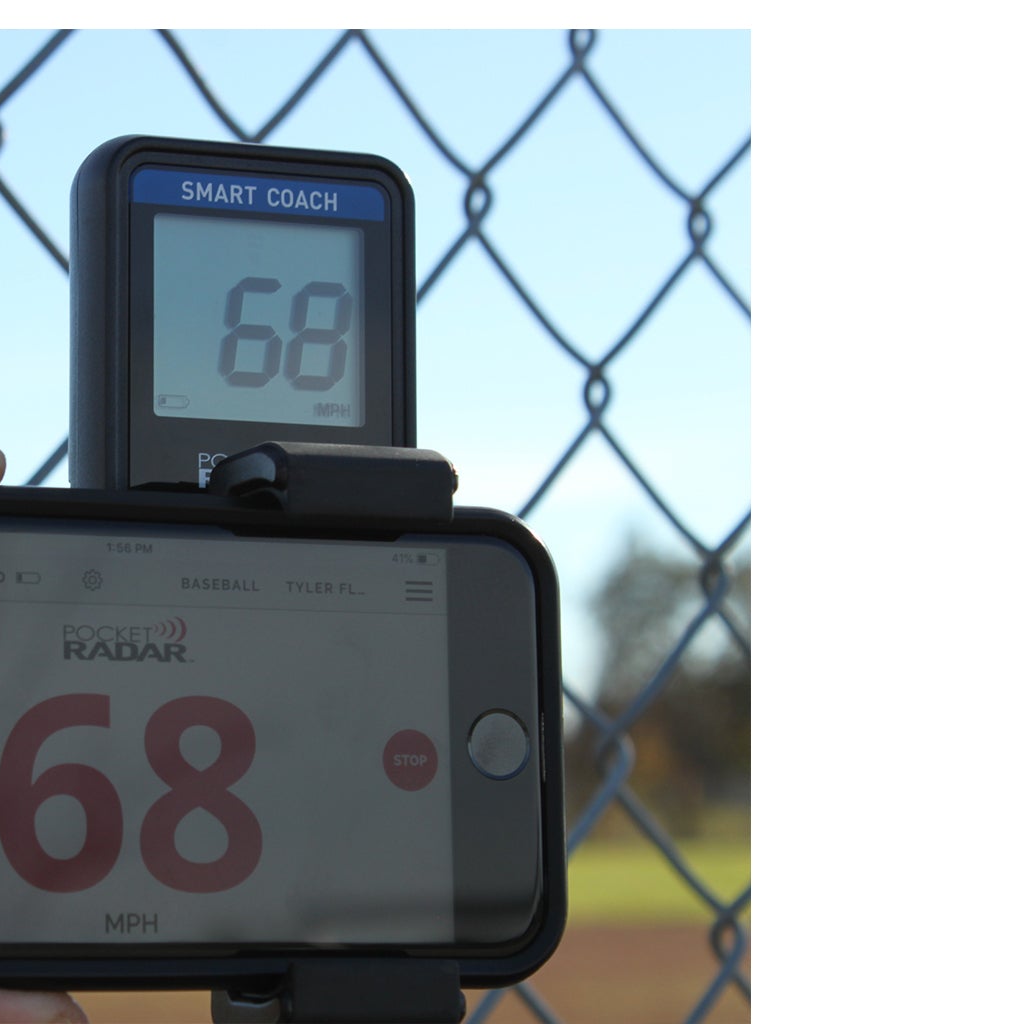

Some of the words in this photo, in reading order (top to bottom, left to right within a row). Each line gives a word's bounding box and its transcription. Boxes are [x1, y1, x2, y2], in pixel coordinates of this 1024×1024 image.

[181, 180, 257, 206] SMART
[267, 187, 338, 212] COACH
[217, 276, 353, 392] 68
[316, 402, 351, 419] MPH
[106, 542, 132, 554] 1:56
[135, 543, 153, 554] PM
[181, 577, 260, 592] BASEBALL
[286, 581, 333, 595] TYLER
[63, 624, 153, 643] POCKET
[63, 640, 187, 663] RADAR
[392, 752, 428, 768] STOP
[104, 912, 159, 935] MPH
